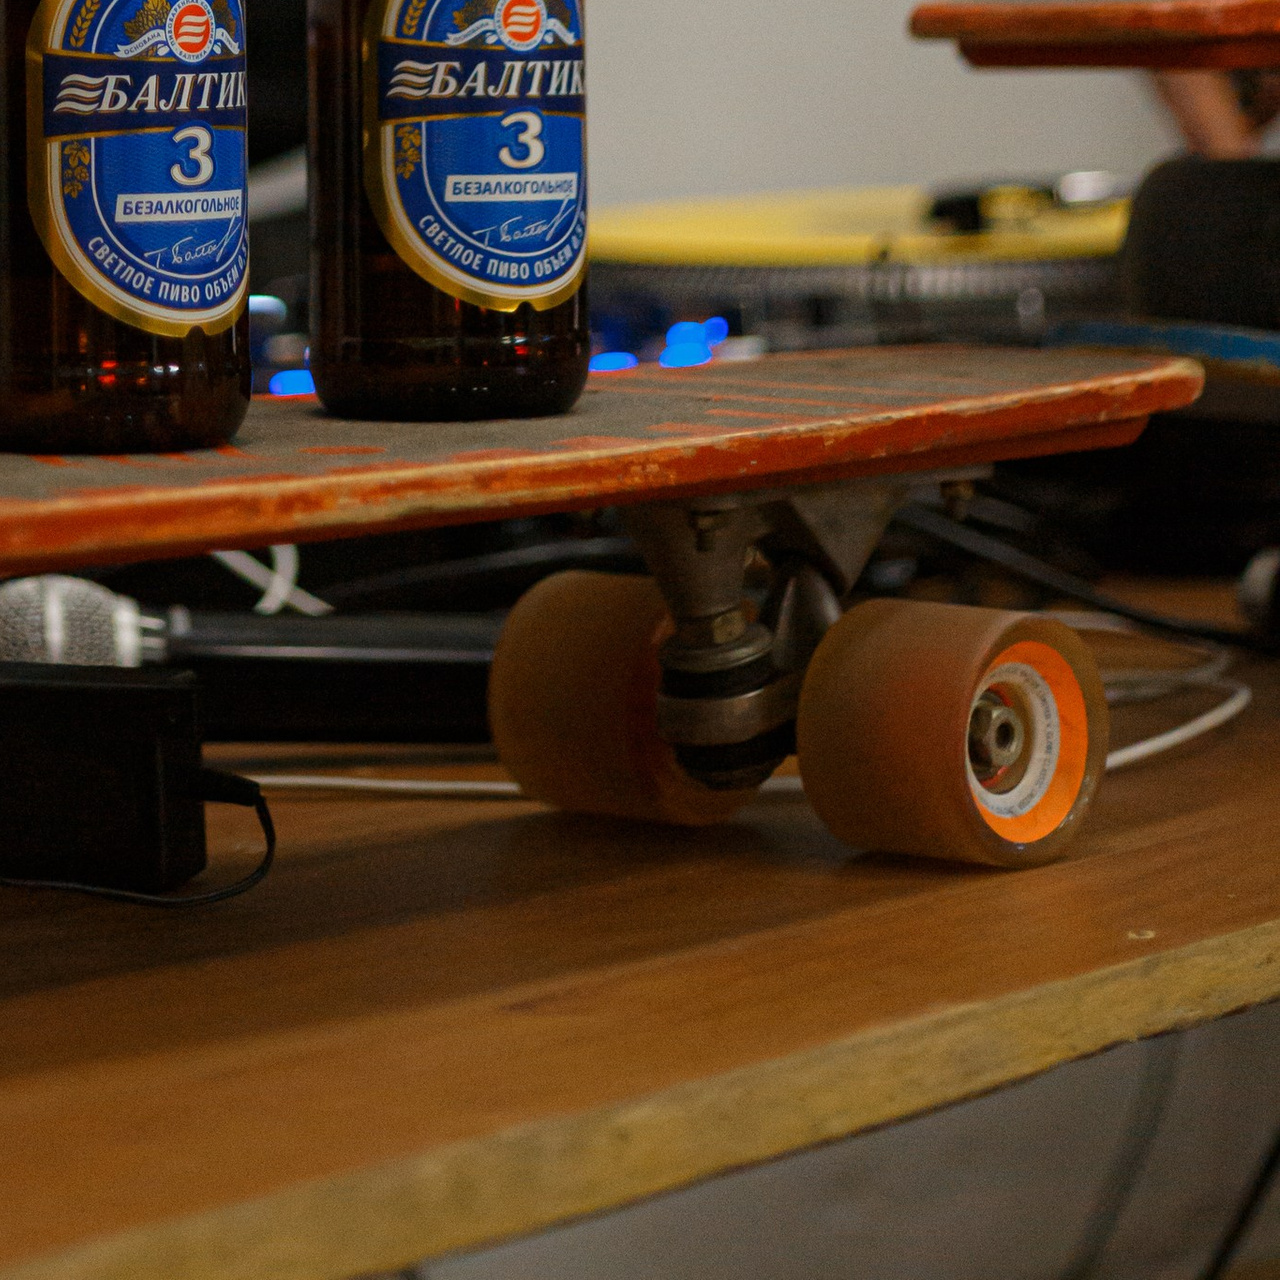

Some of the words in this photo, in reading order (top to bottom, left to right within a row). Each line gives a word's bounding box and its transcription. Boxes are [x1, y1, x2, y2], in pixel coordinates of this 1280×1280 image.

[170, 126, 214, 186] 3
[498, 111, 545, 169] 3
[123, 197, 239, 217] БЕЗАЛКОГОЛЬНОЕ
[452, 180, 574, 197] БЕЗАЛКОГОЛЬНОЕ
[88, 236, 154, 294] СВЕТЛОЕ
[158, 275, 200, 303] ПИВО
[205, 265, 239, 300] ОБЪЕМ
[419, 215, 482, 272] СВЕТЛОЕ
[487, 255, 529, 279] ПИВО
